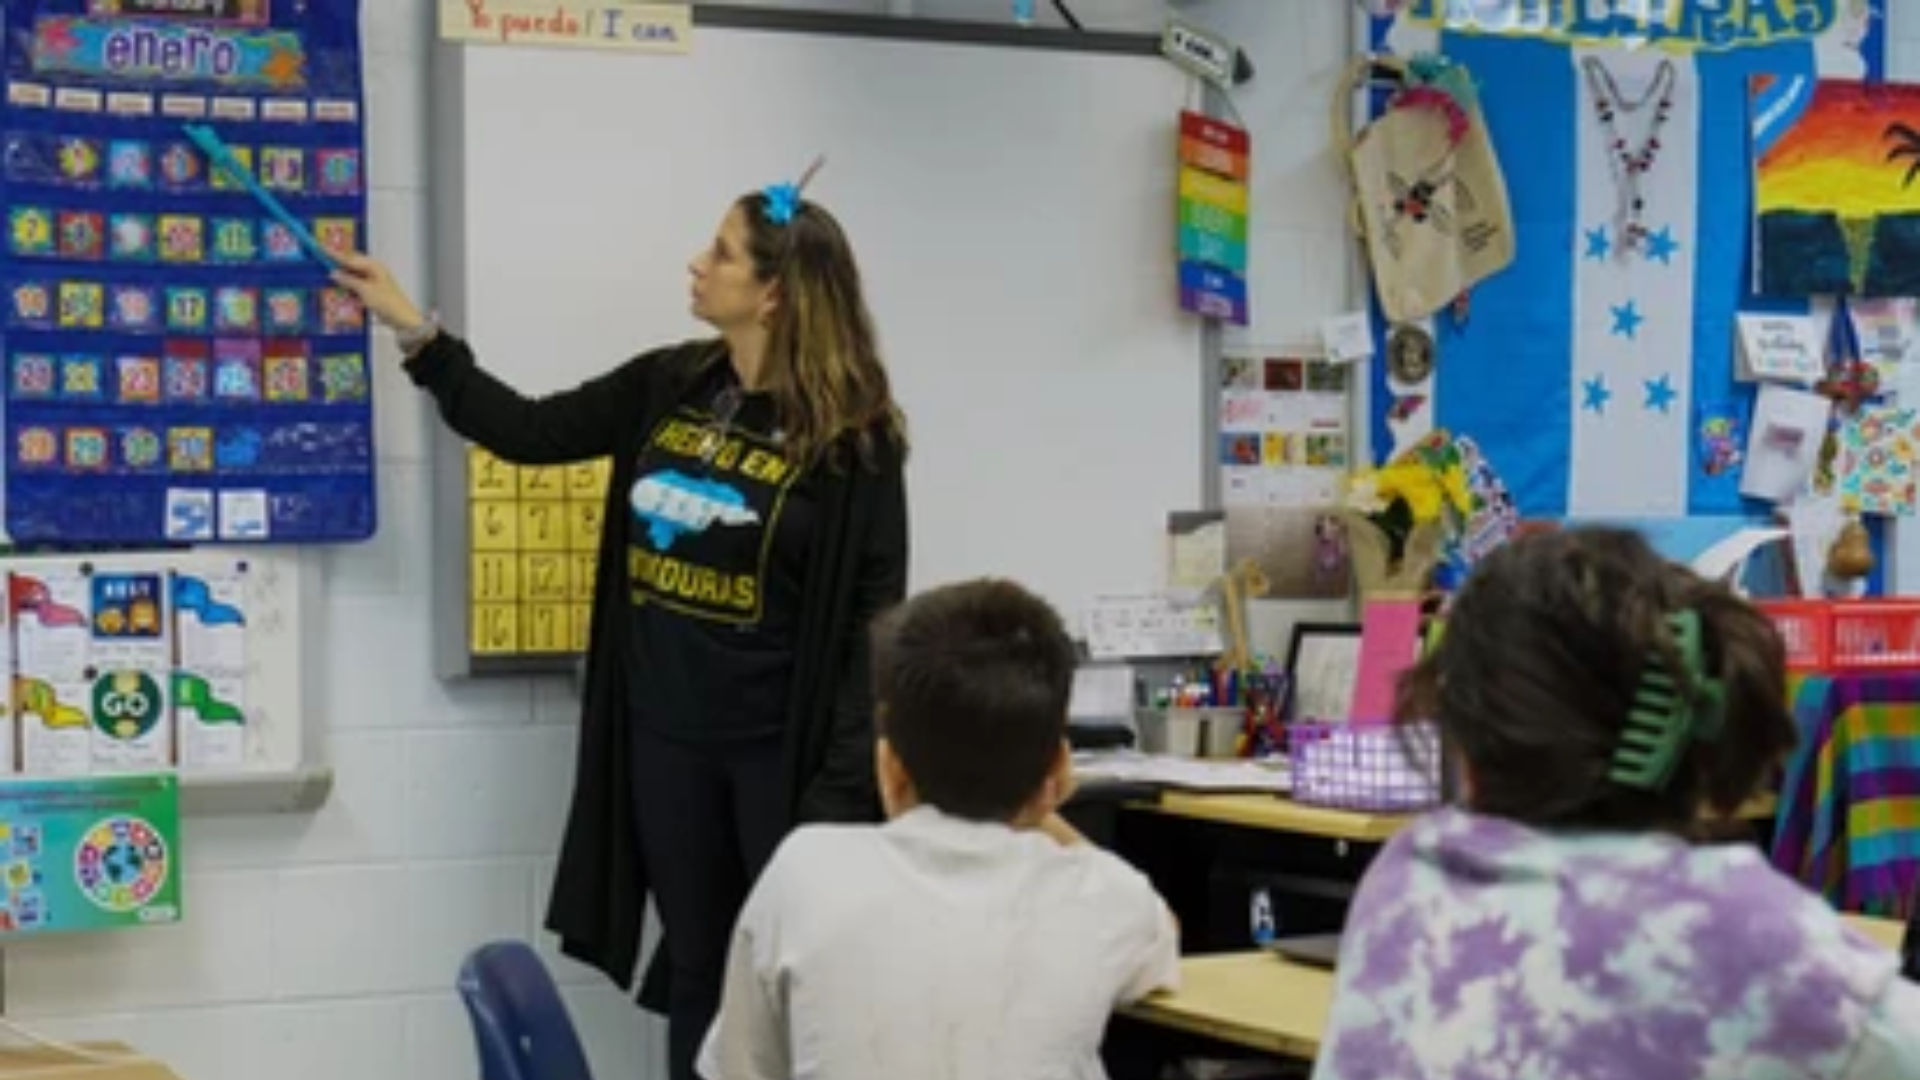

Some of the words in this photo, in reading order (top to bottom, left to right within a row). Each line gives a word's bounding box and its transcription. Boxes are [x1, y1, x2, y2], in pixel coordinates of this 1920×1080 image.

[106, 30, 235, 75] enero
[529, 505, 549, 541] 7
[482, 559, 504, 596] 11
[102, 691, 148, 716] GO
